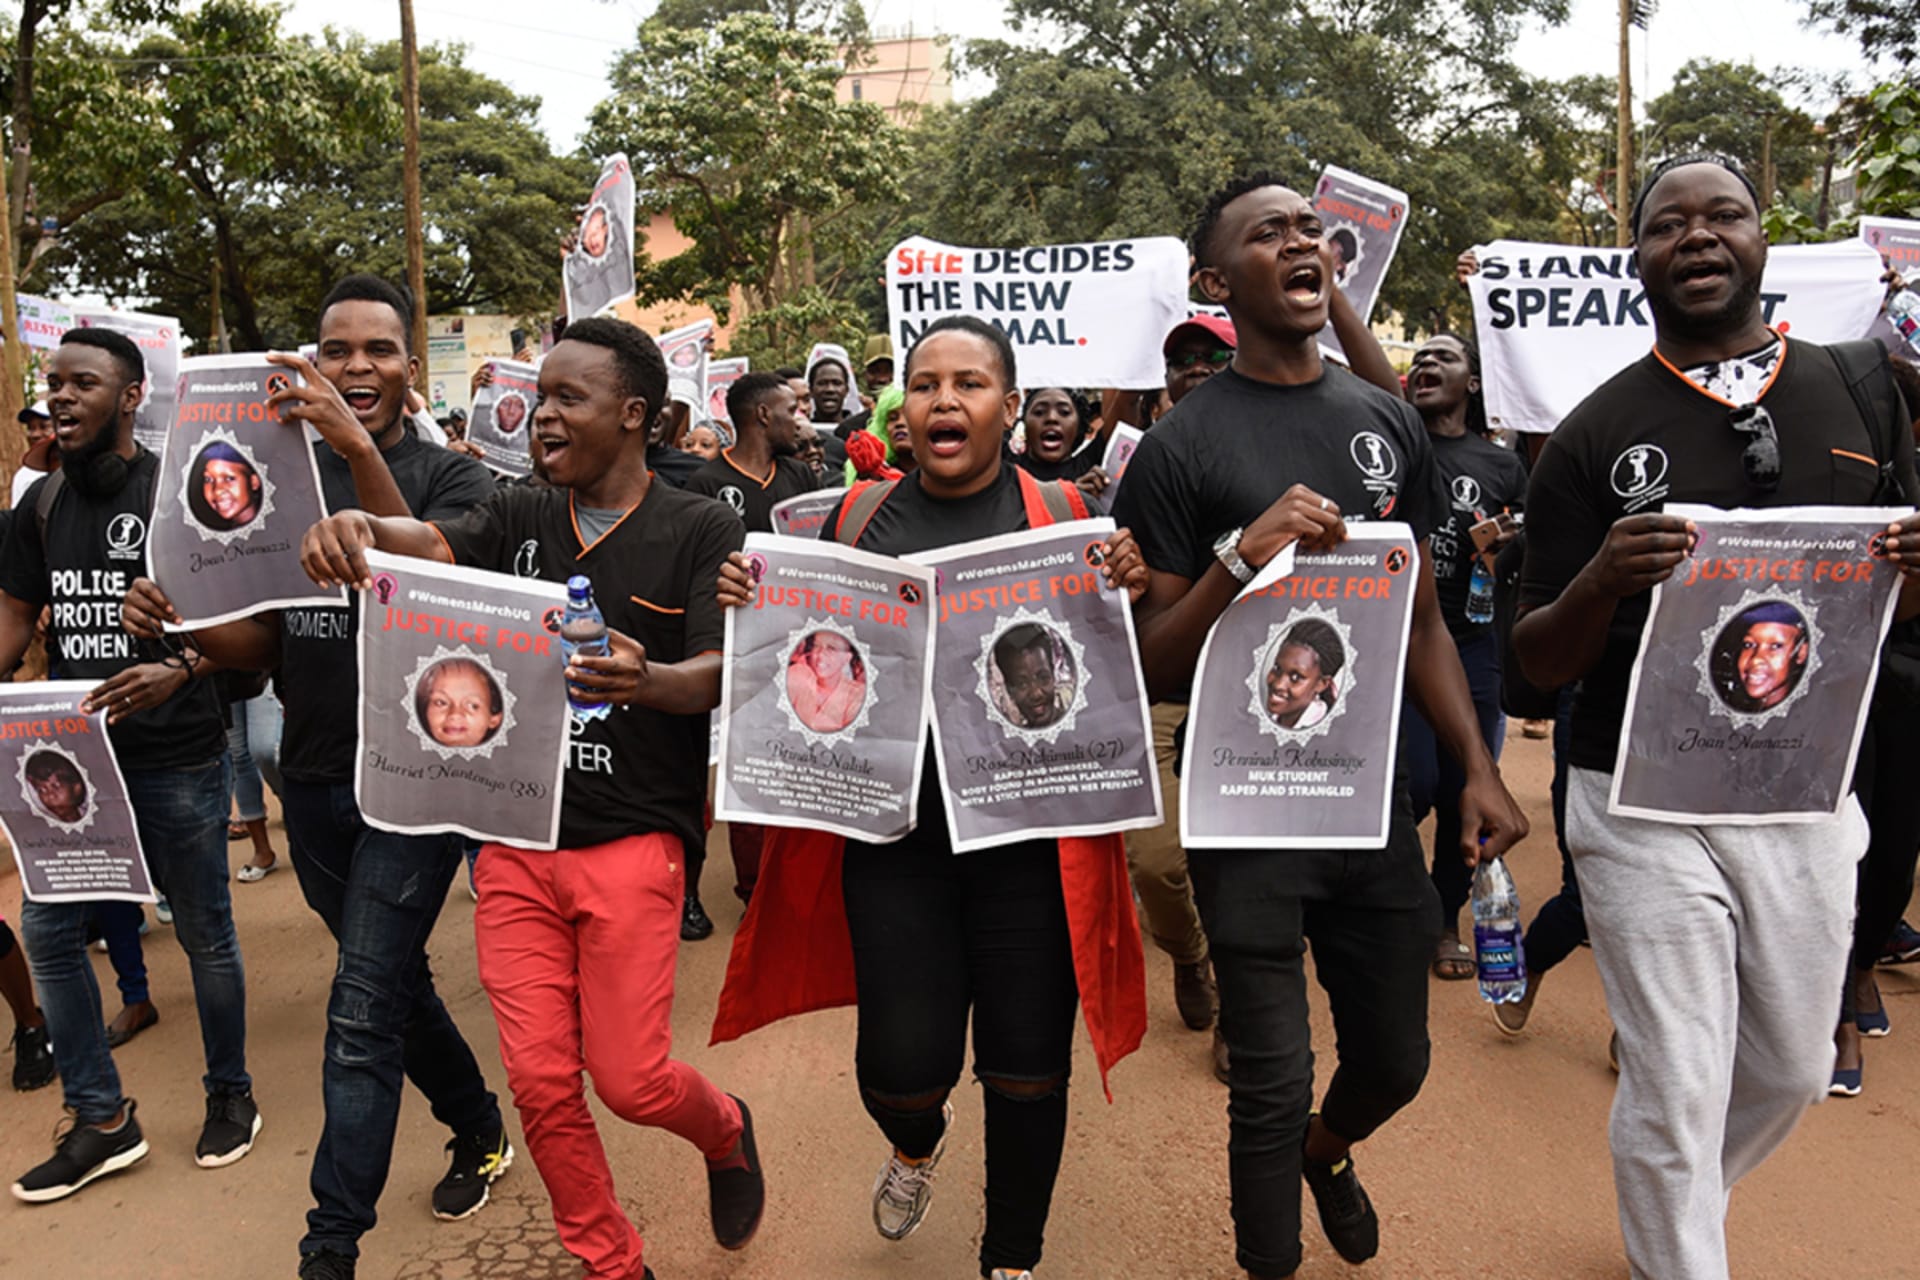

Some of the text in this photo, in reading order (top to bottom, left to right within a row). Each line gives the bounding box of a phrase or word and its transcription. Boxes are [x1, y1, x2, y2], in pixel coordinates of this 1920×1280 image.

[897, 243, 1135, 275] SHE DECIDES
[897, 281, 1072, 312] THE NEW
[1487, 288, 1649, 330] SPEAK
[901, 317, 1088, 348] NMAL.
[176, 402, 233, 428] JUSTICE
[1717, 535, 1857, 551] #WomensMarchUG
[777, 566, 889, 593] #WomensMarchUG
[956, 551, 1075, 581] #WomensMarchUG
[1684, 557, 1875, 587] JUSTICE FOR
[51, 569, 127, 597] POLICE
[939, 572, 1099, 623] JUSTICE FOR
[1343, 576, 1392, 600] FOR
[53, 602, 124, 628] PROTE
[407, 589, 532, 622] #WomensMarchUG
[753, 585, 909, 629] JUSTICE FOR
[382, 607, 552, 657] JUSTICE FOR
[54, 717, 92, 736] FOR
[1678, 728, 1725, 753] Joan
[1087, 737, 1125, 761] (27)
[368, 750, 425, 780] Harriet
[509, 779, 547, 800] (38)
[1277, 770, 1330, 783] STUDENT
[1219, 784, 1356, 798] RAPED AND STRANGLED
